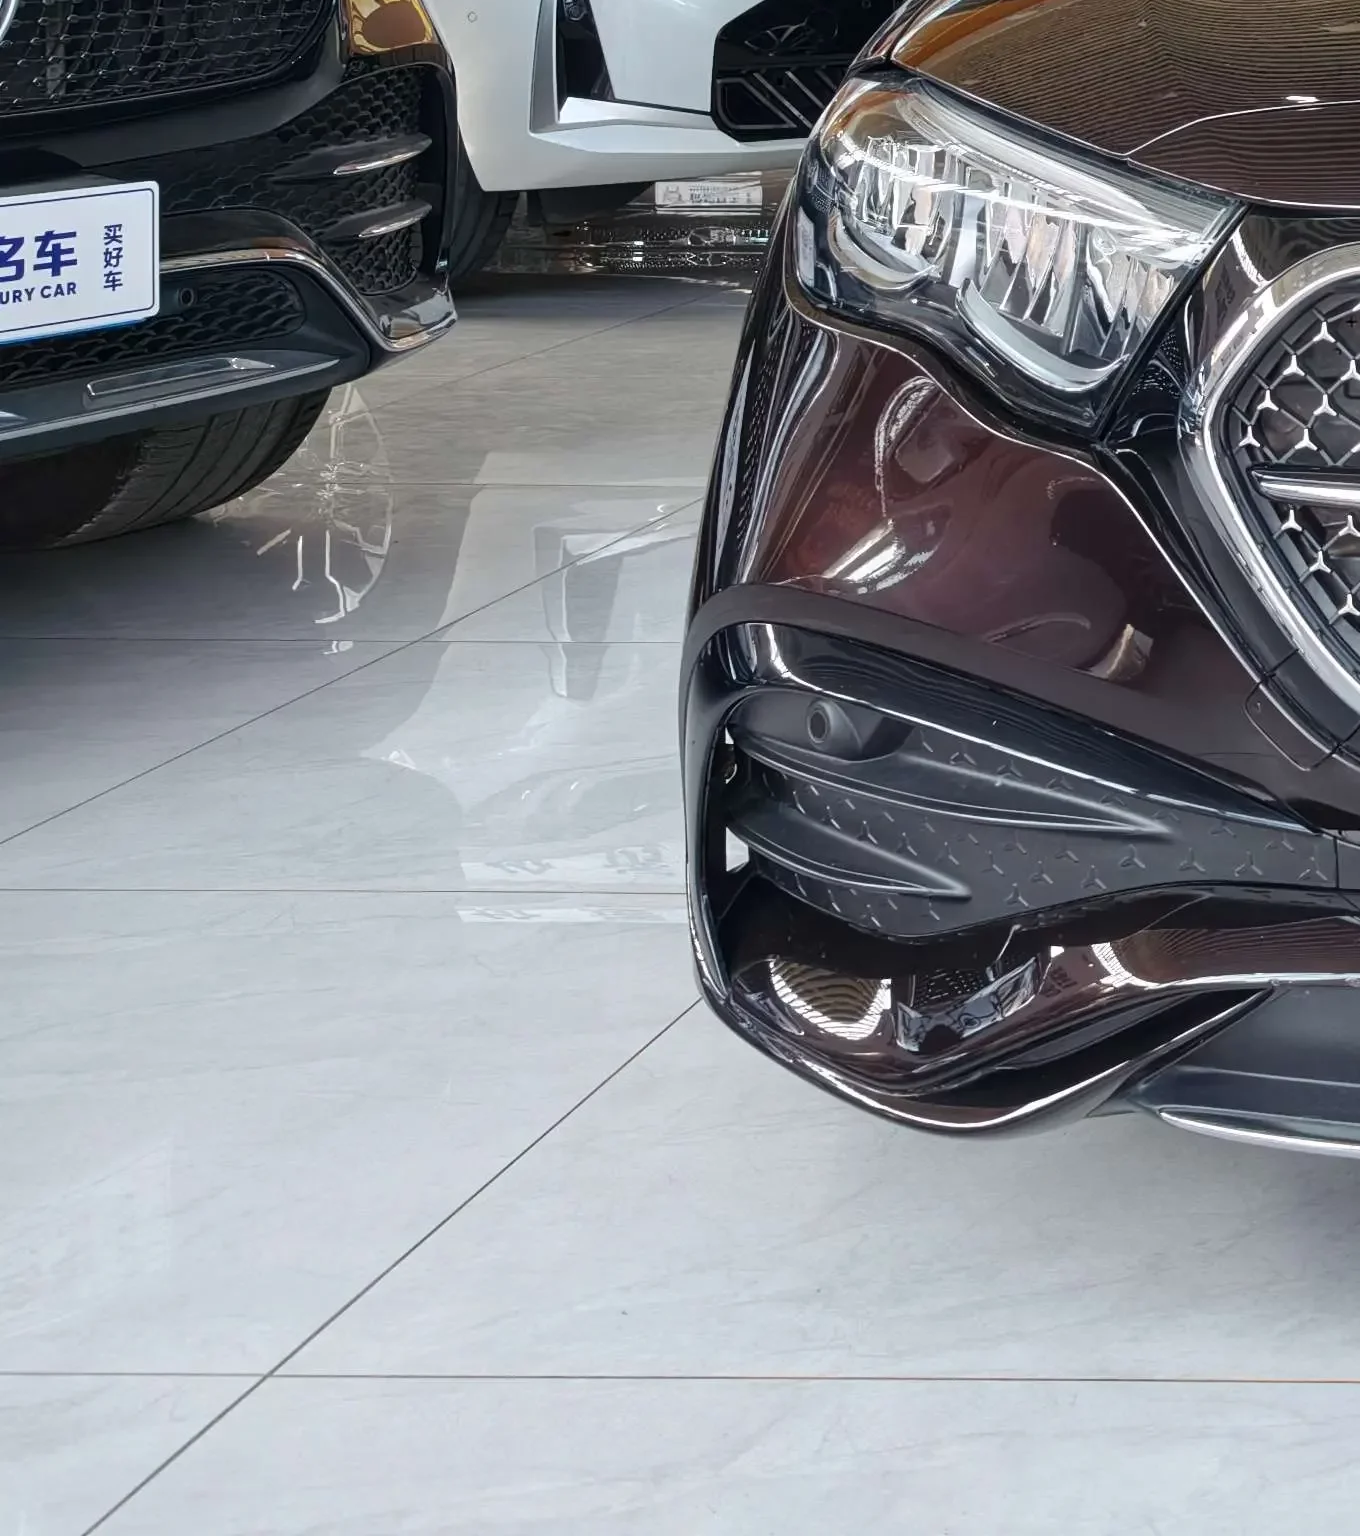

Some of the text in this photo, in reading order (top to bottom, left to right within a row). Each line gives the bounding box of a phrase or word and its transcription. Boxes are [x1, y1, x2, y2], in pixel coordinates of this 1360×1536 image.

[103, 223, 124, 292] 买好车
[40, 282, 77, 299] CAR
